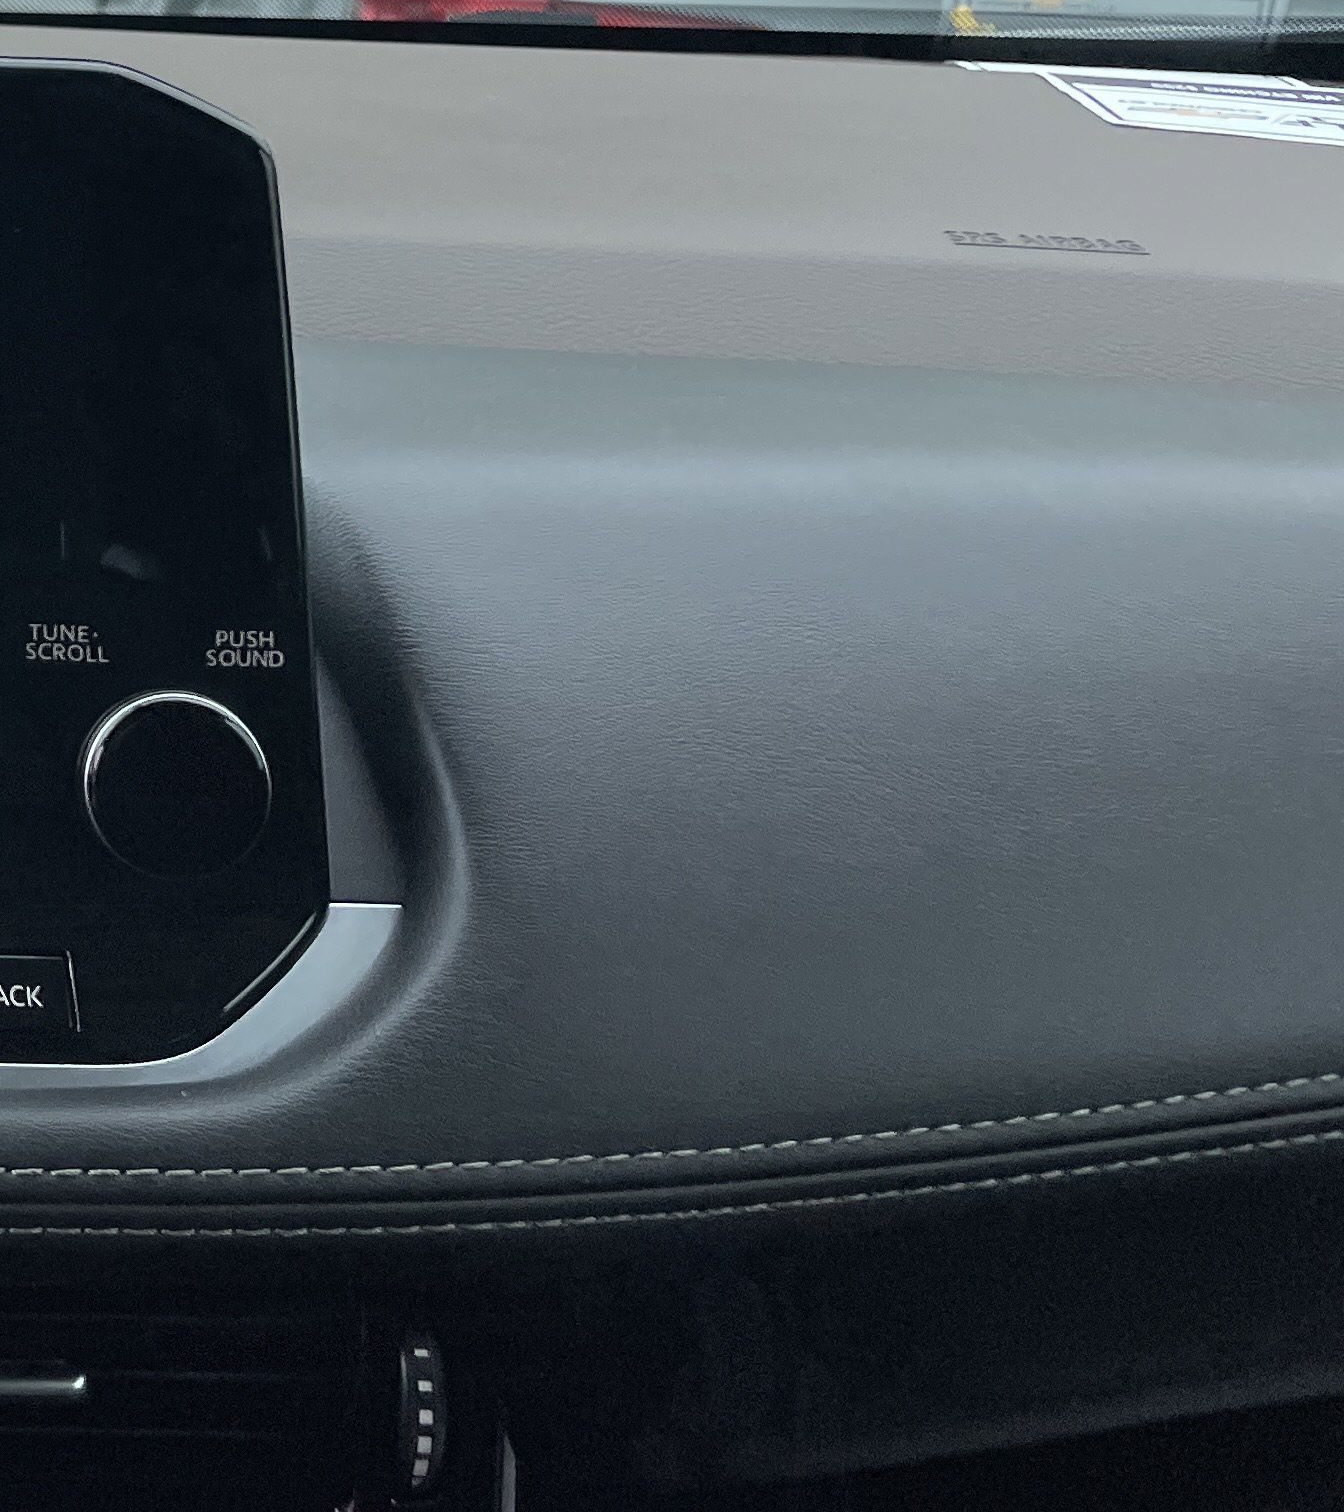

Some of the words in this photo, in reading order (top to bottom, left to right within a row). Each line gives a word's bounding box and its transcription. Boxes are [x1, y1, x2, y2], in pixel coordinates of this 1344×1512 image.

[215, 630, 275, 648] PUSH
[25, 642, 109, 663] SCROLL
[205, 649, 285, 668] SOUND
